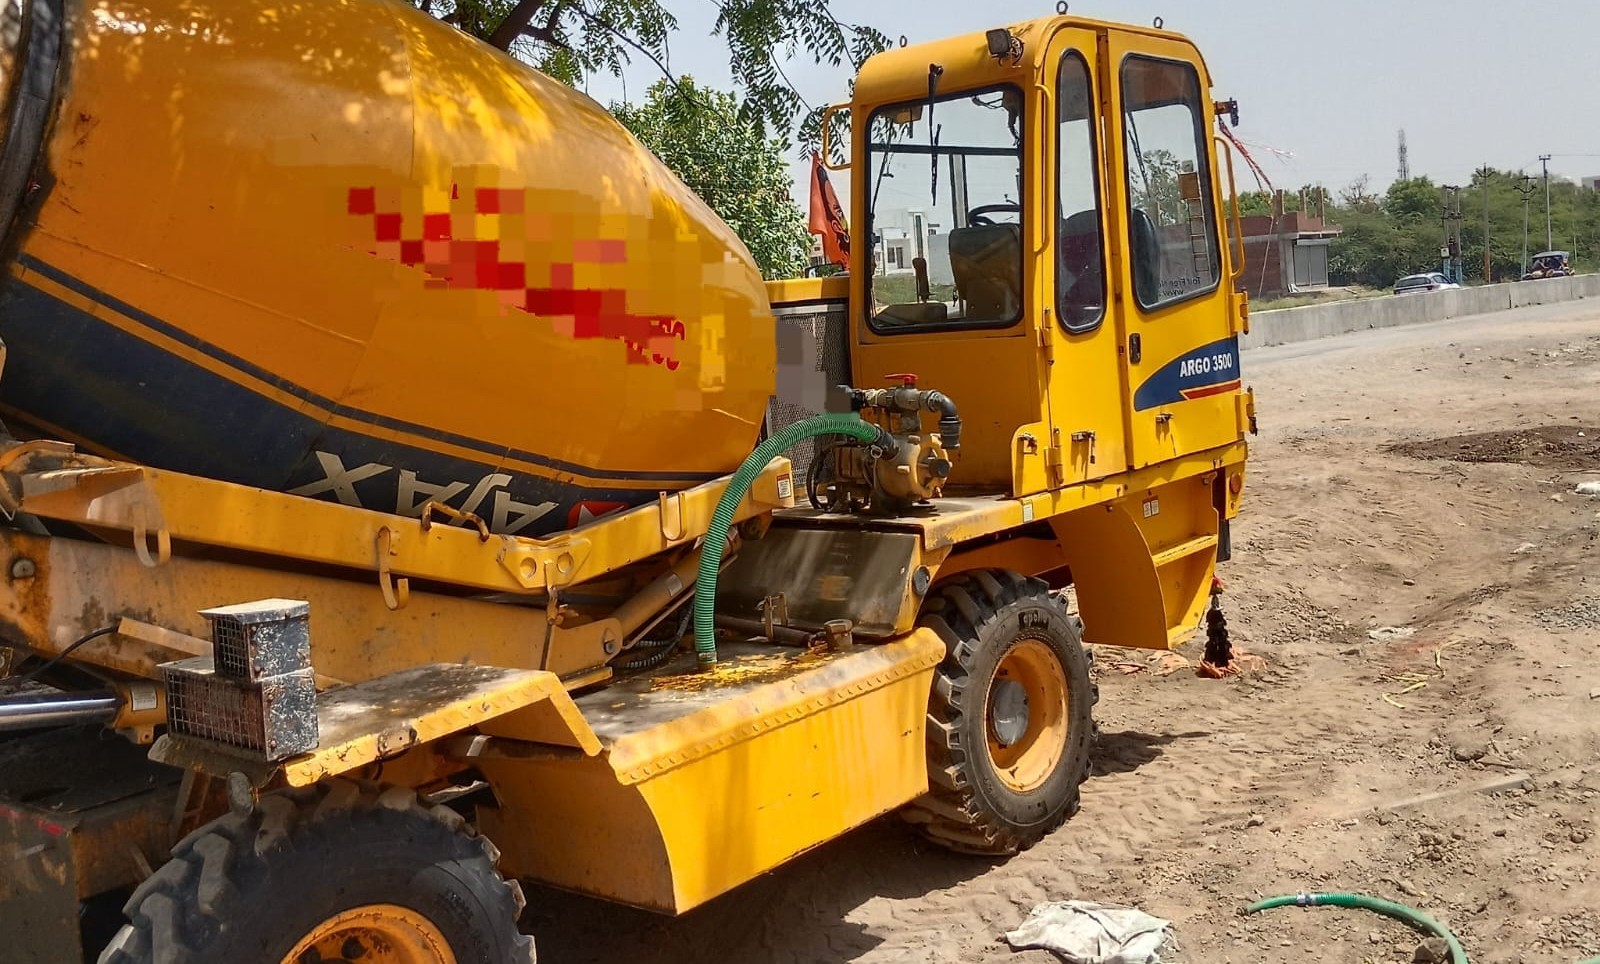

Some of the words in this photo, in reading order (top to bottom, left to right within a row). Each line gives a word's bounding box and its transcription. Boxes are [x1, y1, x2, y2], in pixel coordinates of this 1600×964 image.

[1180, 358, 1211, 378] ARGO
[1213, 352, 1232, 371] 3500
[285, 450, 559, 535] AJAX
